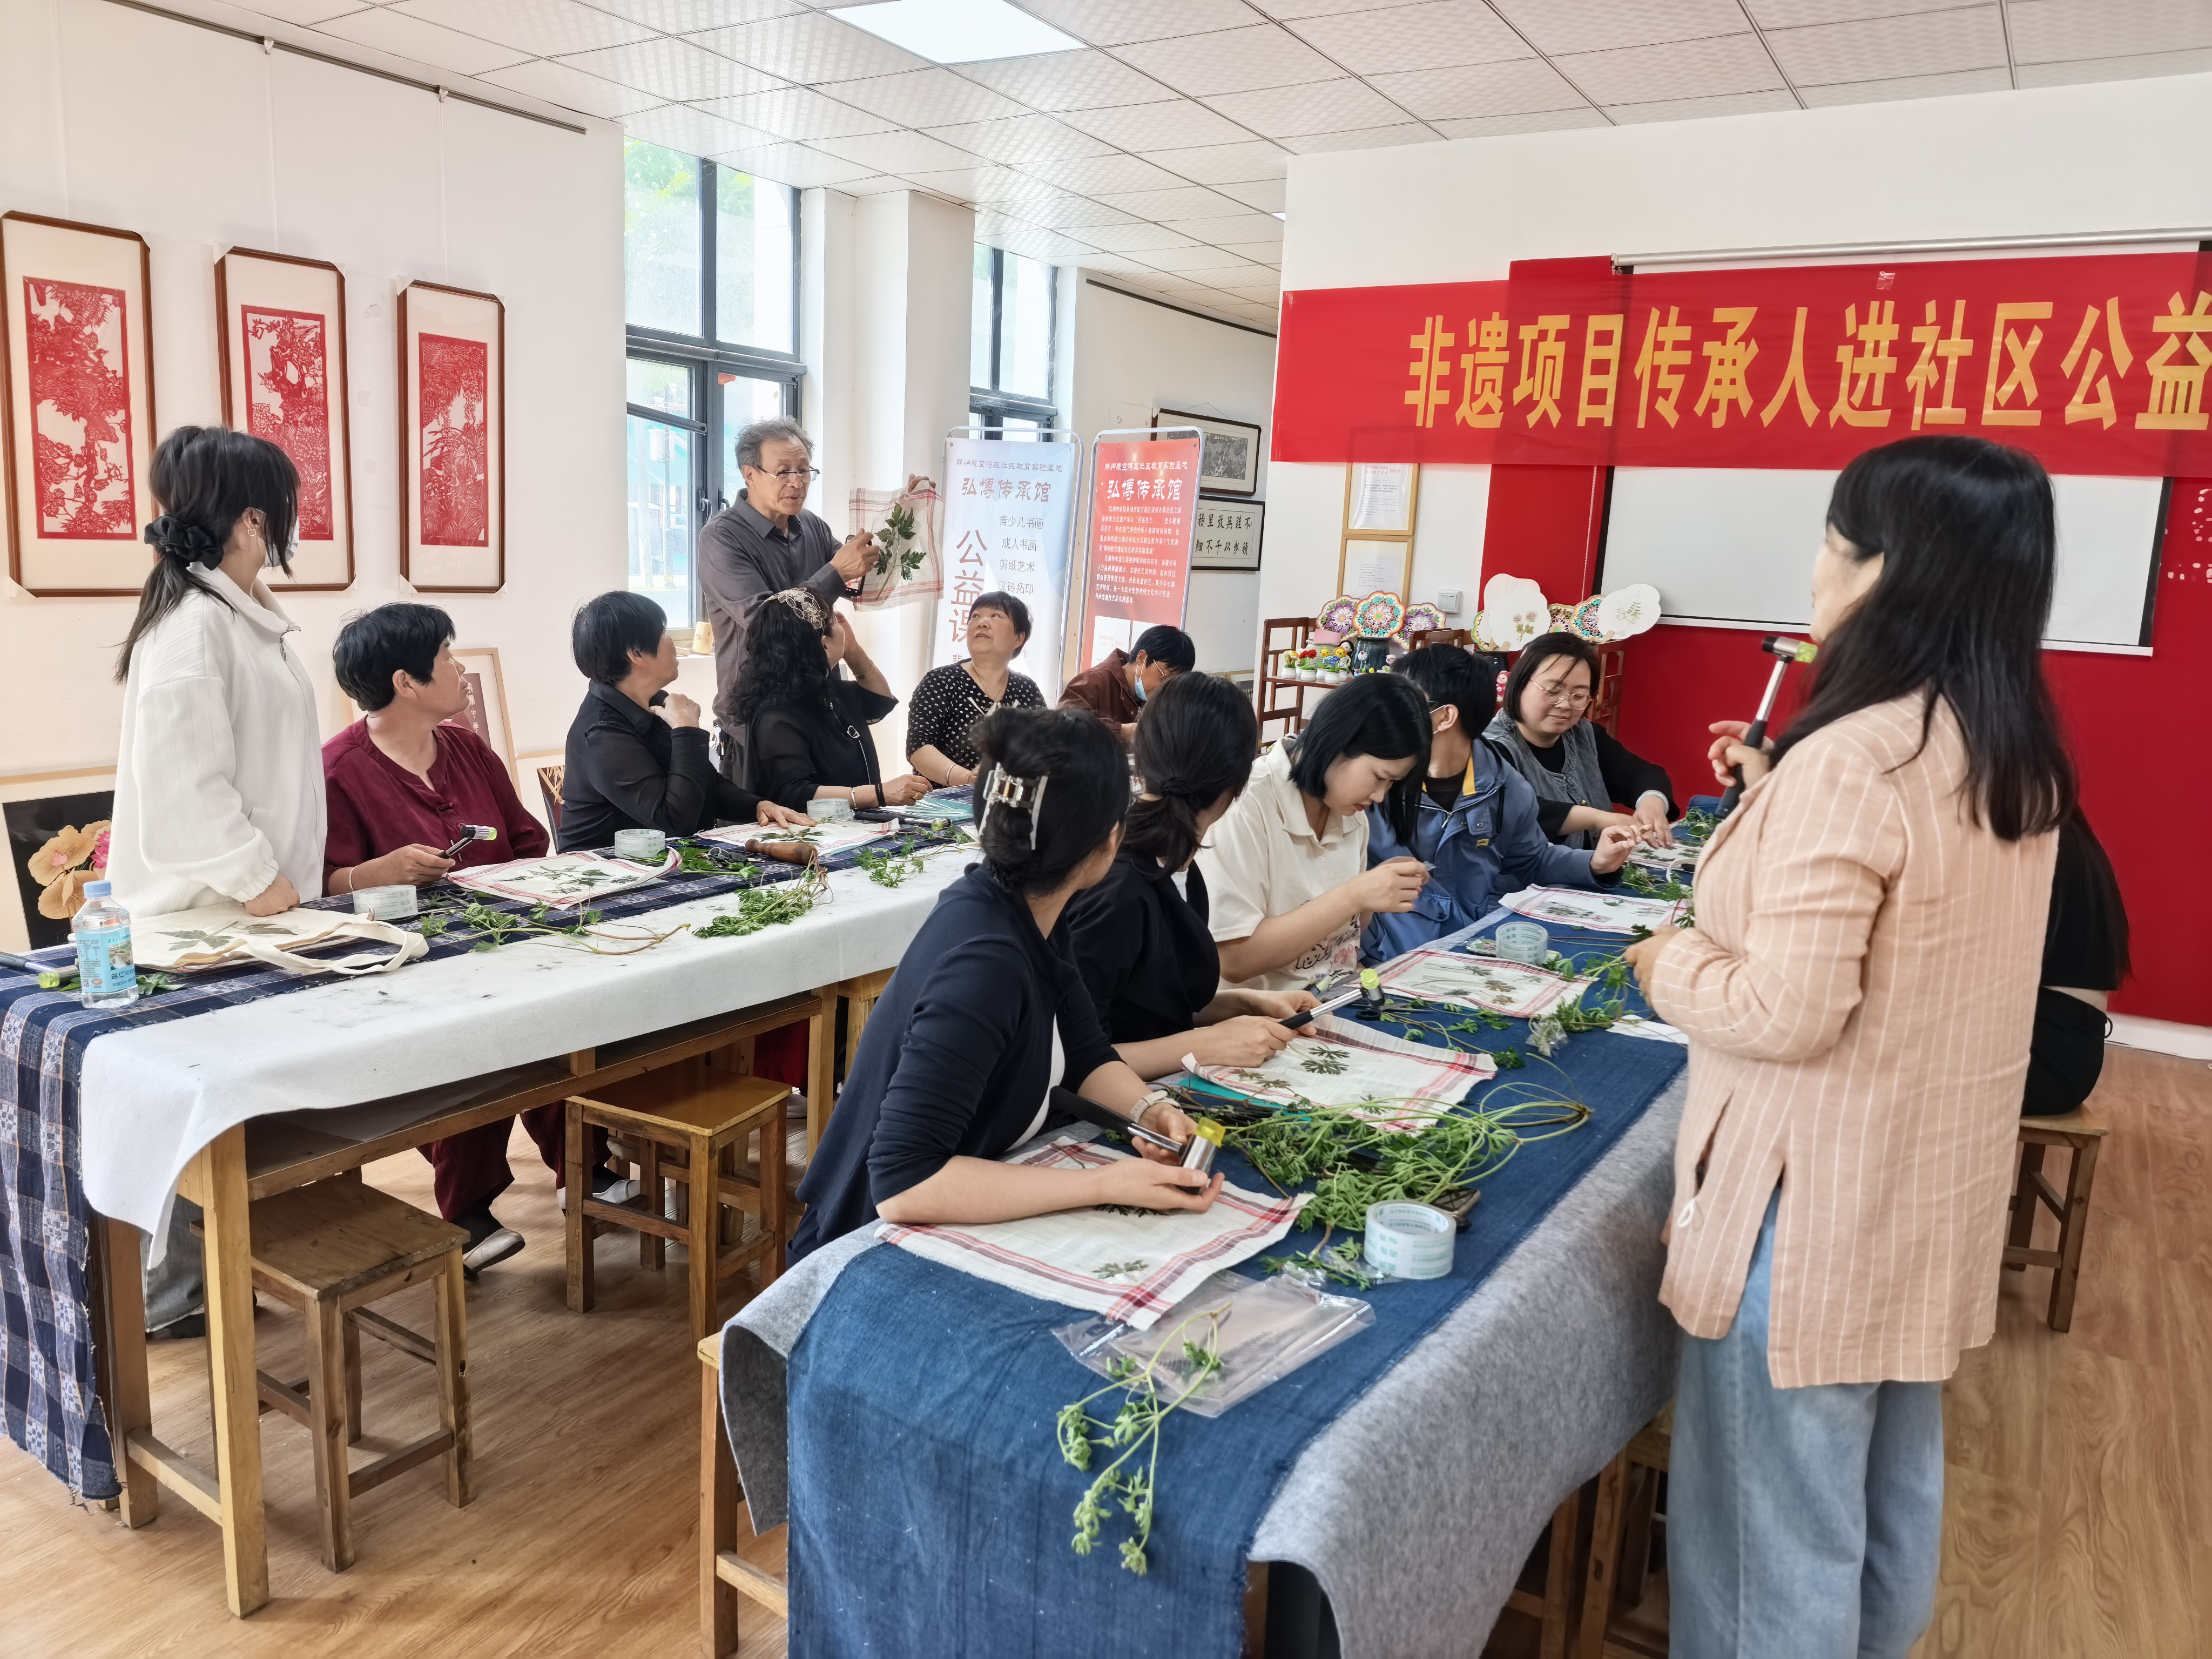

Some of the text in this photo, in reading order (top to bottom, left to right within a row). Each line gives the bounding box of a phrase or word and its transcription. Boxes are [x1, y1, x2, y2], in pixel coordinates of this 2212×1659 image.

[1404, 291, 2212, 430] 非遗项目传承人进社区公益
[956, 458, 1063, 473] 郑州航空港区社区教育实验基地
[1104, 461, 1188, 471] 郑州航空港区社区教育实验基地
[962, 477, 1051, 502] 弘博传承馆
[1107, 478, 1183, 502] 弘博传承馆
[999, 515, 1044, 530] 青少儿书画
[1002, 537, 1037, 551] 成人书画
[999, 558, 1035, 573] 剪纸艺术
[998, 580, 1034, 595] 汉砖拓印
